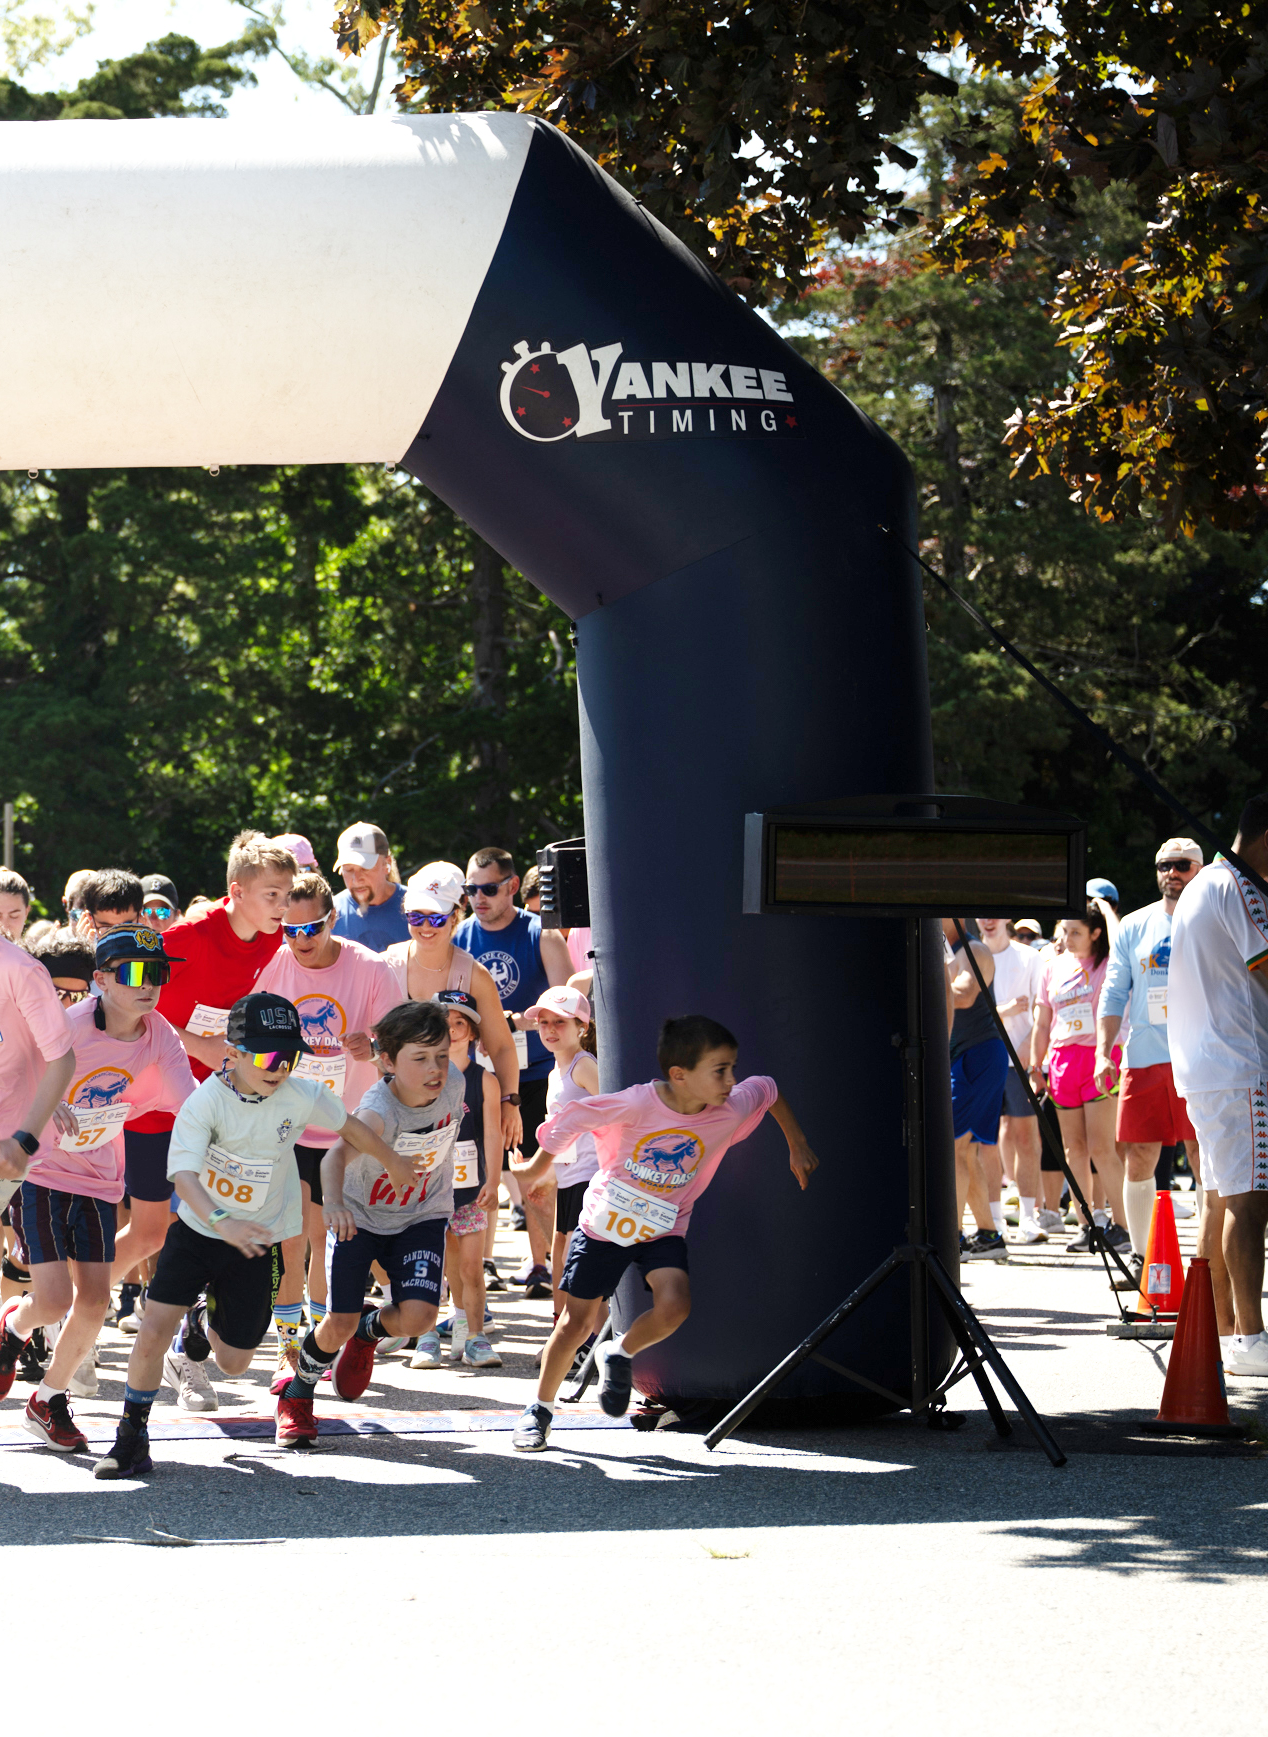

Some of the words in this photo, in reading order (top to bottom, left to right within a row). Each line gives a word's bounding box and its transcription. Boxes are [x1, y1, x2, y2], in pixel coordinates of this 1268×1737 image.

[556, 342, 793, 437] YANKEE
[619, 410, 777, 434] TIMING
[497, 952, 512, 964] COD
[260, 1007, 297, 1027] USA
[1162, 1005, 1167, 1019] 1
[1066, 1020, 1083, 1032] 79
[303, 1037, 322, 1046] KEY
[325, 1037, 343, 1046] DAS
[75, 1127, 107, 1146] 57
[412, 1151, 437, 1167] 3
[624, 1157, 670, 1184] DONKEY
[207, 1169, 253, 1203] 108
[605, 1211, 655, 1244] 105
[403, 1250, 441, 1268] SANDWICH
[414, 1260, 428, 1278] S
[401, 1279, 438, 1292] LACROSSE
